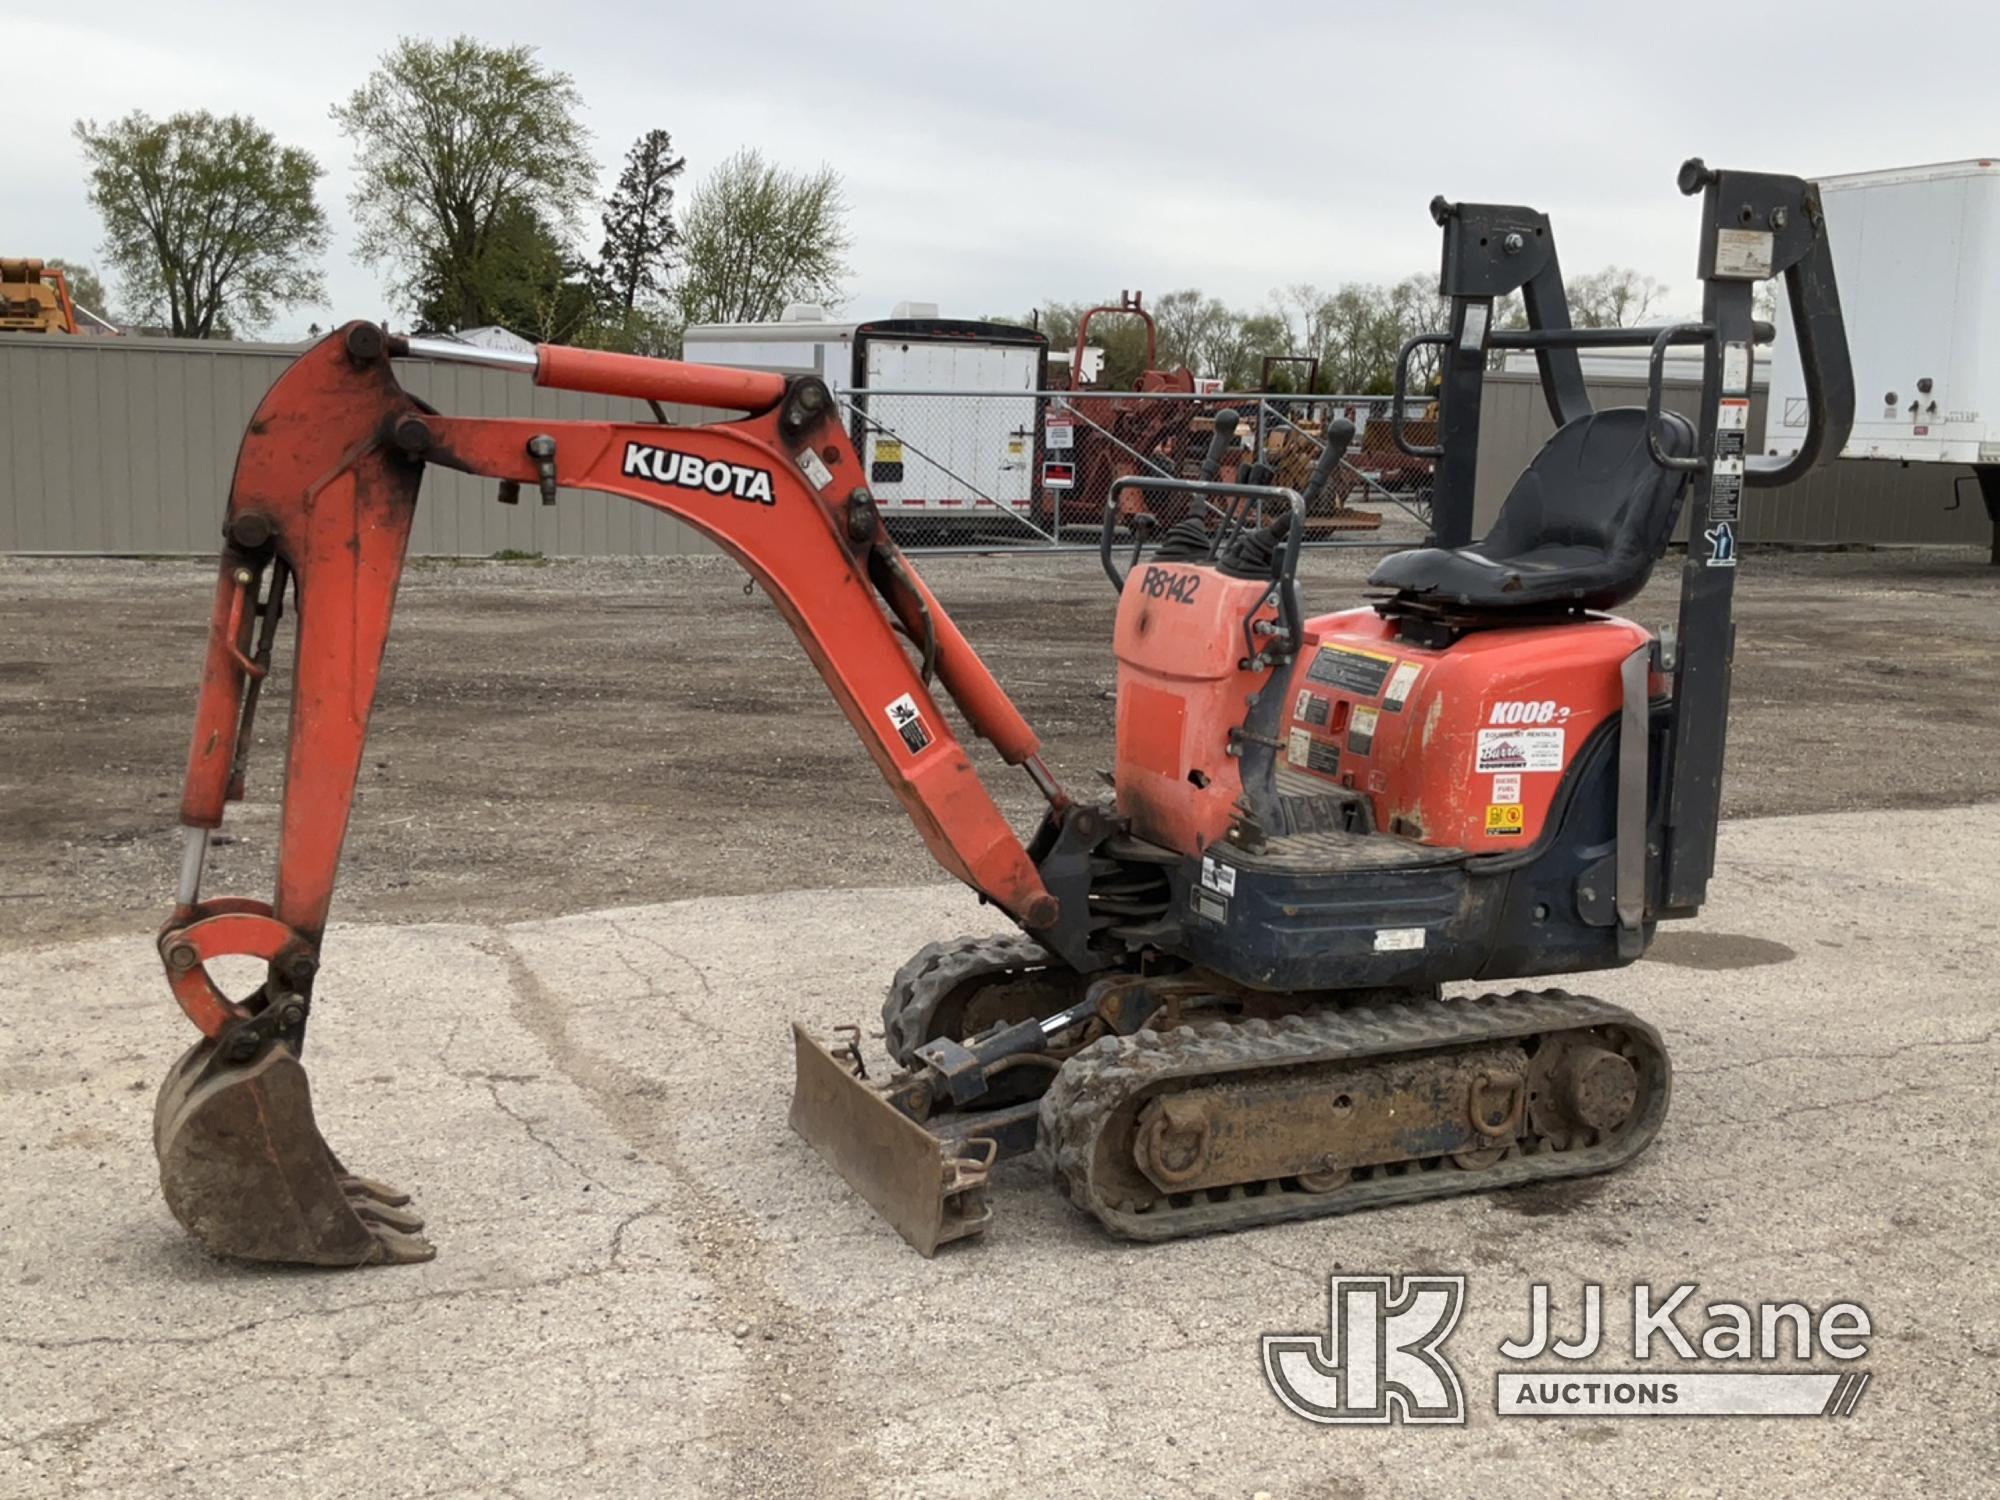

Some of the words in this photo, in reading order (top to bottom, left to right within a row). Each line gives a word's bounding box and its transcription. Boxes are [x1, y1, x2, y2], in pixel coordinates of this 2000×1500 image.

[623, 443, 773, 503] KUBOTA
[1140, 566, 1200, 604] R8142
[1488, 701, 1571, 724] K008-3
